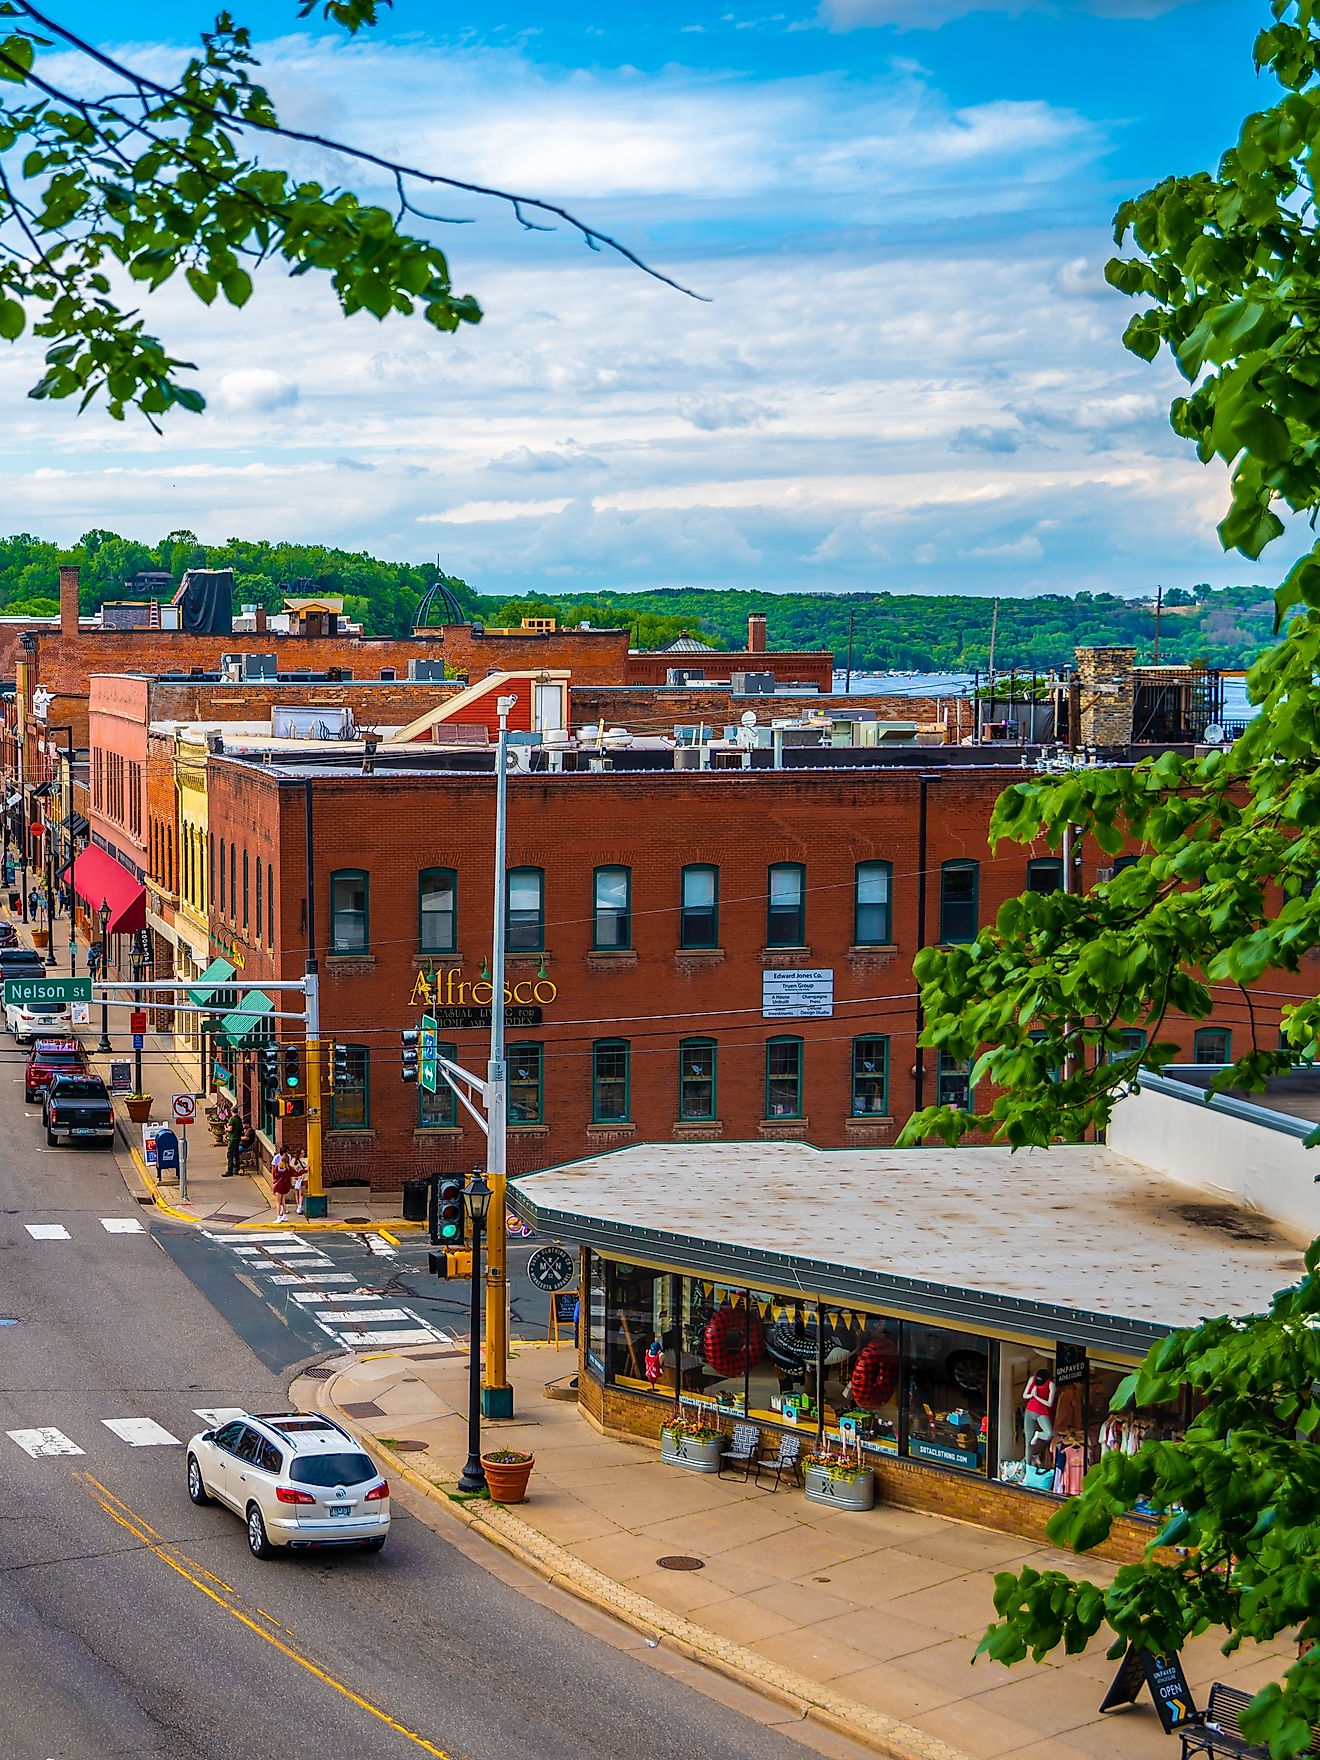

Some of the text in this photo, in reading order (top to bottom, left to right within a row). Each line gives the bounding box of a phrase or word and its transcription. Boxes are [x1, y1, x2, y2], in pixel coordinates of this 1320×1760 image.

[141, 930, 150, 961] ROOFTOP
[11, 984, 85, 999] Nelson St
[407, 967, 557, 1005] Alfresco
[435, 1009, 534, 1018] CASUAL LIVG FOR
[470, 1019, 486, 1027] AND
[541, 1247, 567, 1258] CLOTHING
[539, 1262, 561, 1270] M N
[531, 1272, 572, 1290] MINNESOTA APPAREL
[1056, 1362, 1085, 1375] UNPAVED
[920, 1446, 968, 1463] SOTACLOTHING.COM
[1160, 1683, 1182, 1698] OPEN
